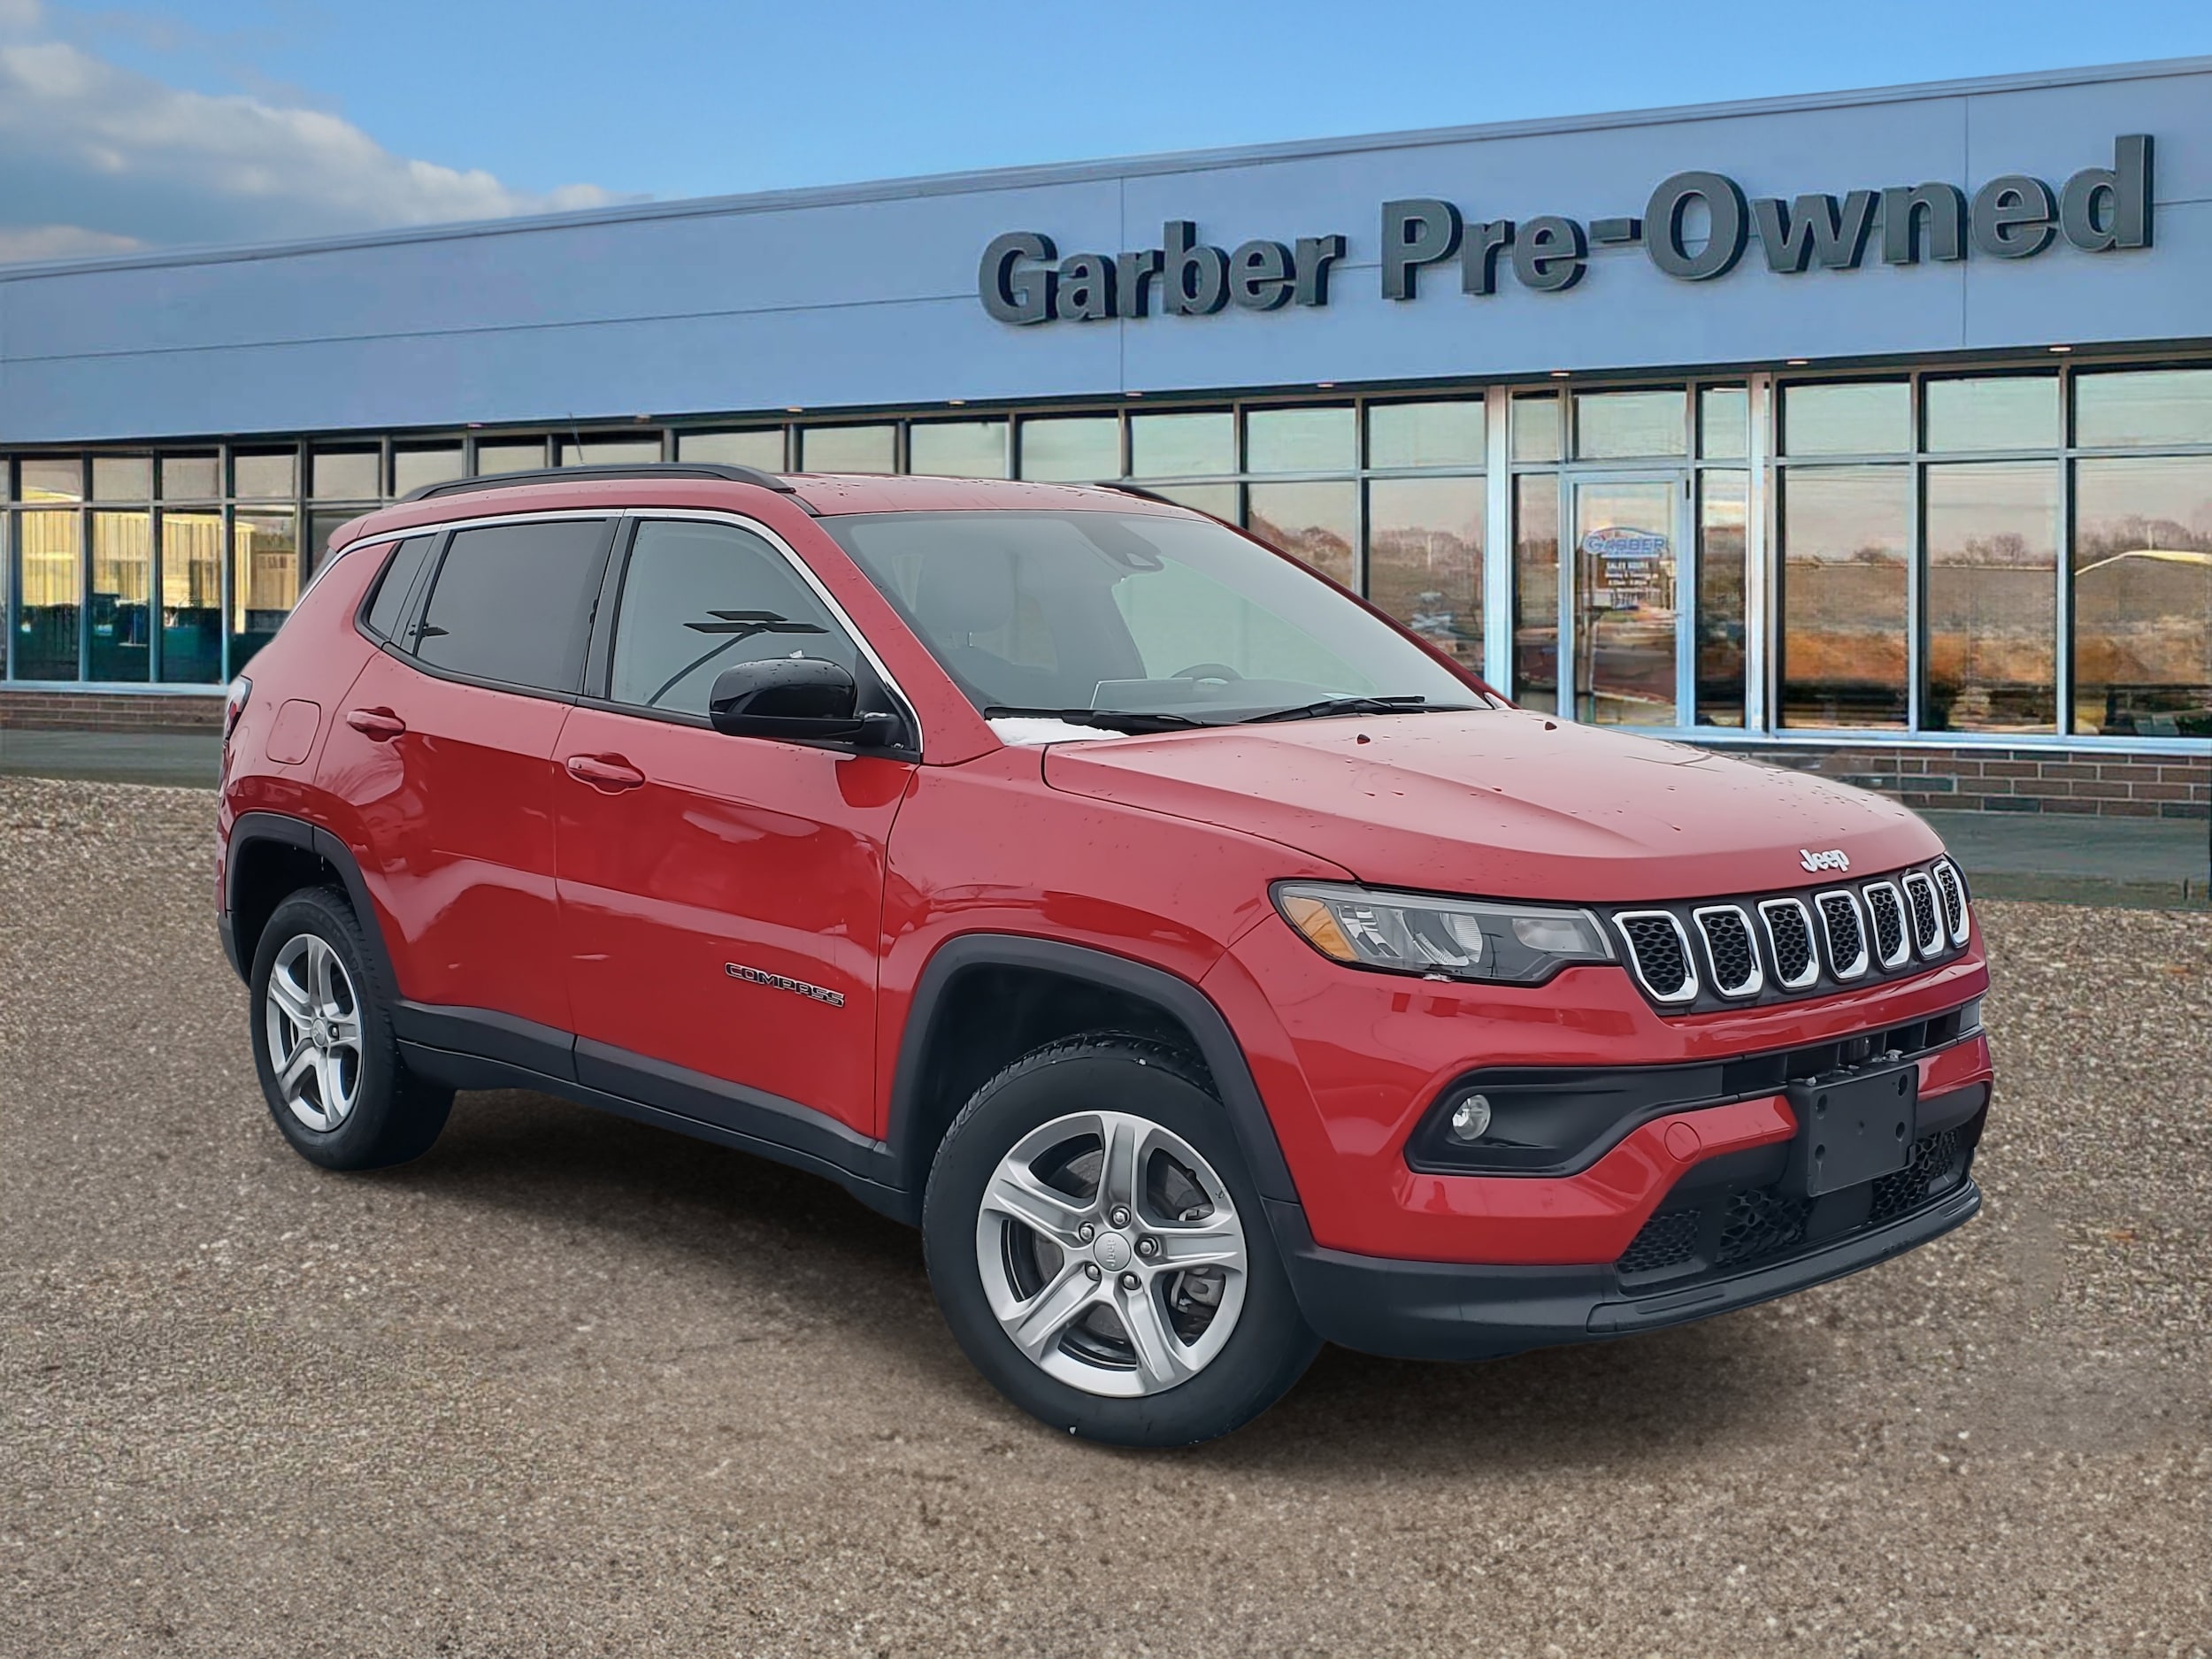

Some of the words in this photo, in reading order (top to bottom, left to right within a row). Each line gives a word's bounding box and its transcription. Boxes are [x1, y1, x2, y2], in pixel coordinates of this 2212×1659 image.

[979, 220, 1346, 326] Garber
[1381, 134, 2154, 301] Pre-Owned
[1588, 535, 1665, 551] GARBER
[1799, 849, 1850, 872] Jeep
[725, 962, 845, 1008] COMPASS
